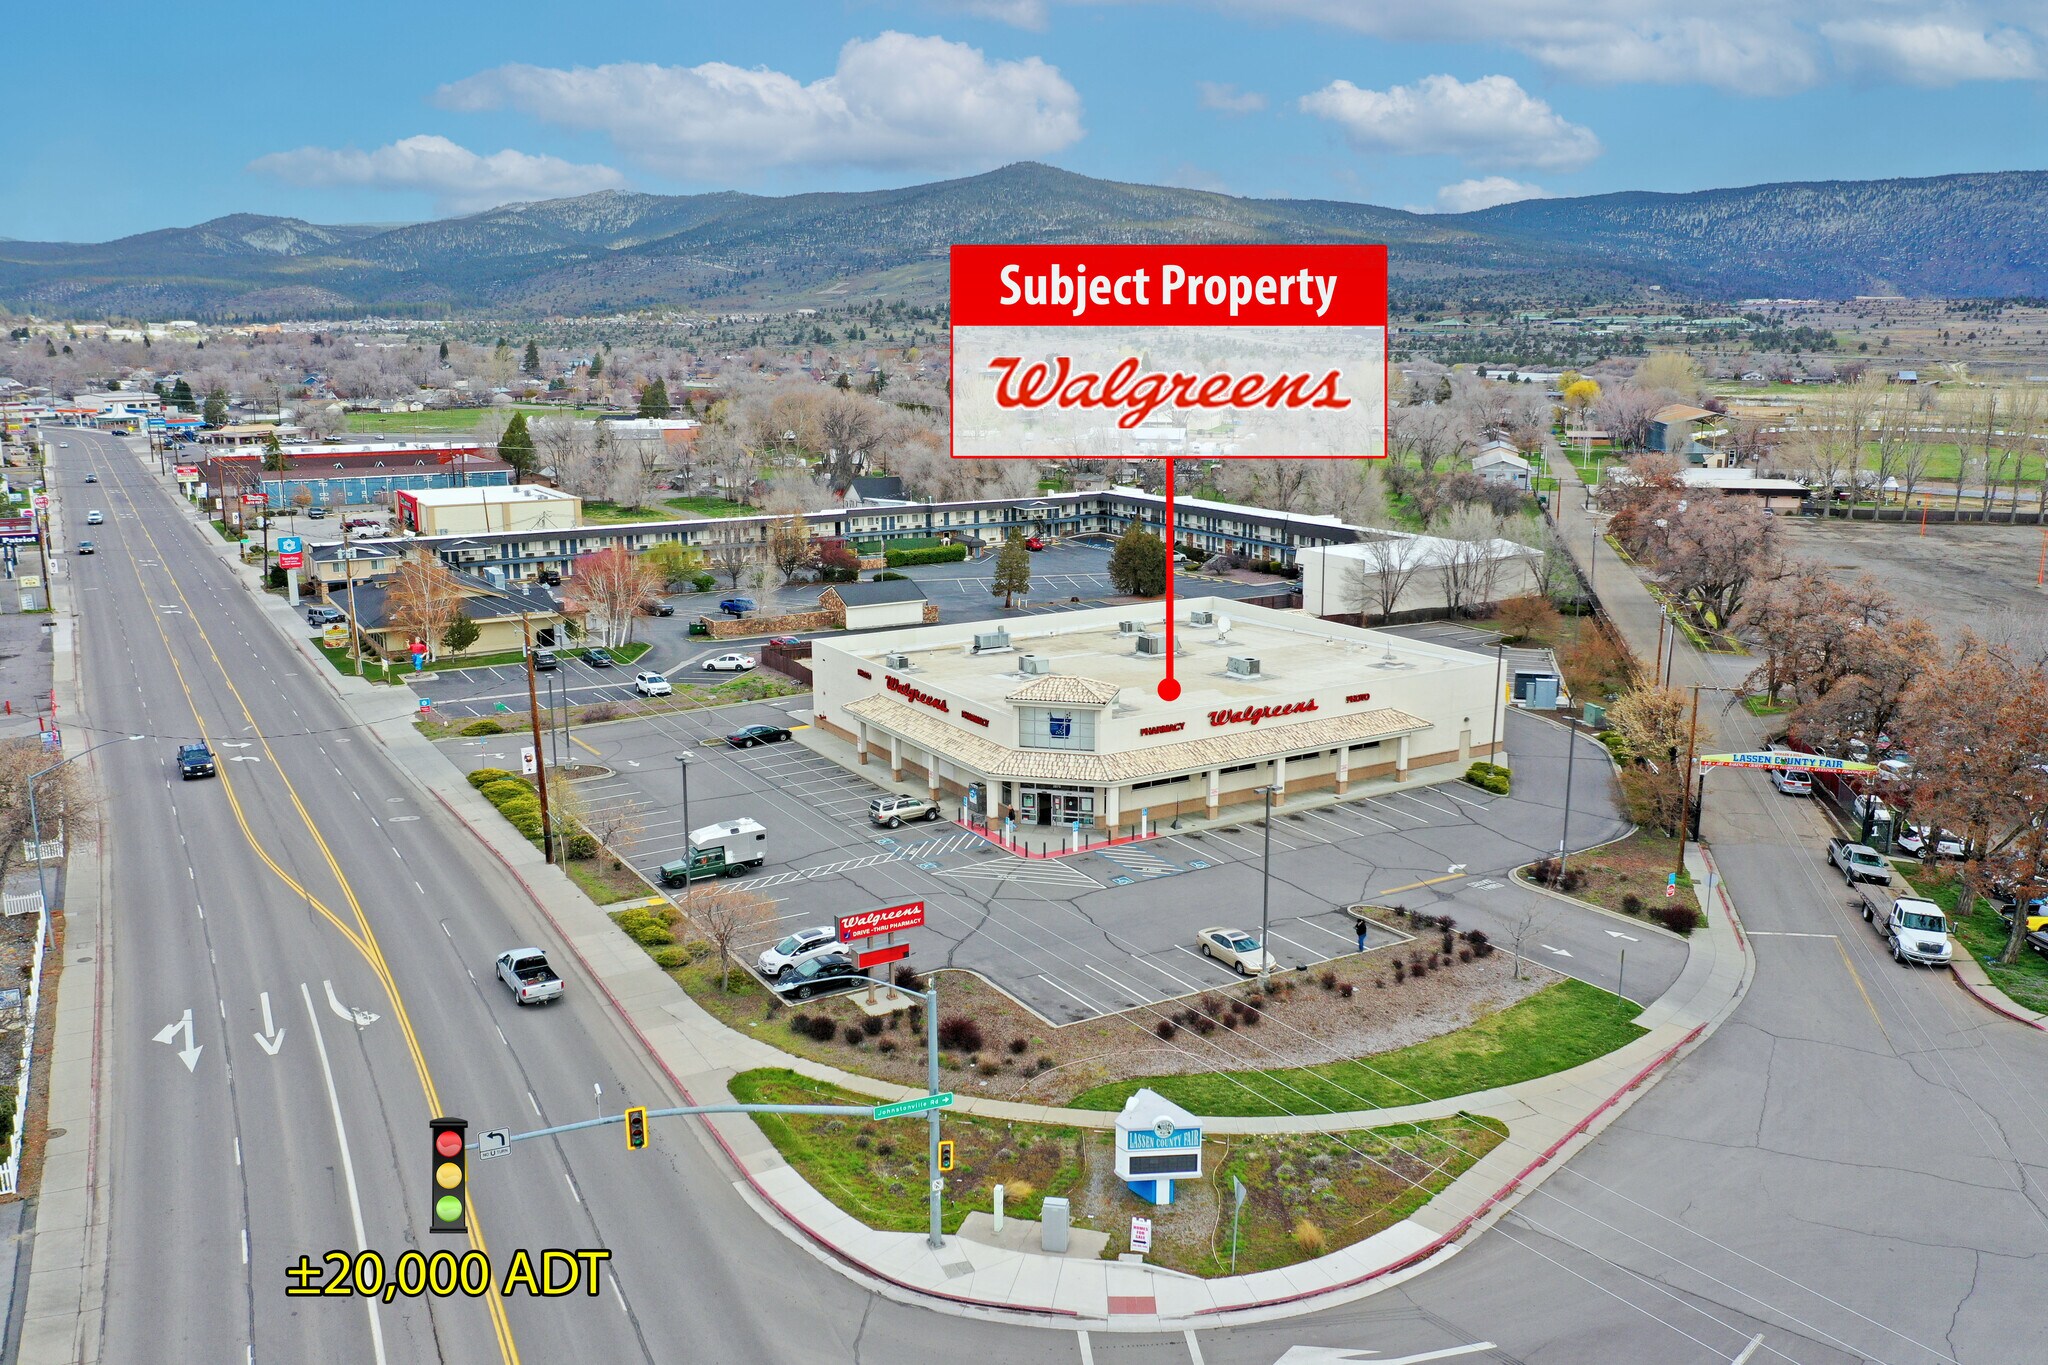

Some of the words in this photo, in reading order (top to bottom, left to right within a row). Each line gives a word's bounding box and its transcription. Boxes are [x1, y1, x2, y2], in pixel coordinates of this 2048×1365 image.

[885, 675, 949, 713] Walgreens
[1346, 693, 1370, 703] PHOTO
[1207, 698, 1319, 727] Walgreens
[1140, 722, 1185, 736] PHARMACY
[1733, 754, 1771, 763] LASSEN
[1775, 756, 1815, 766] CUNTY
[1820, 759, 1843, 768] FAIR
[1871, 825, 1879, 837] 1
[841, 906, 922, 928] Walgreens
[852, 928, 870, 937] DRIVE
[889, 918, 922, 929] PHARMACY
[878, 1101, 927, 1116] Johnstonville
[1129, 1131, 1155, 1149] LASSEN
[1156, 1134, 1182, 1148] COUNTY
[1183, 1129, 1199, 1146] FAIR
